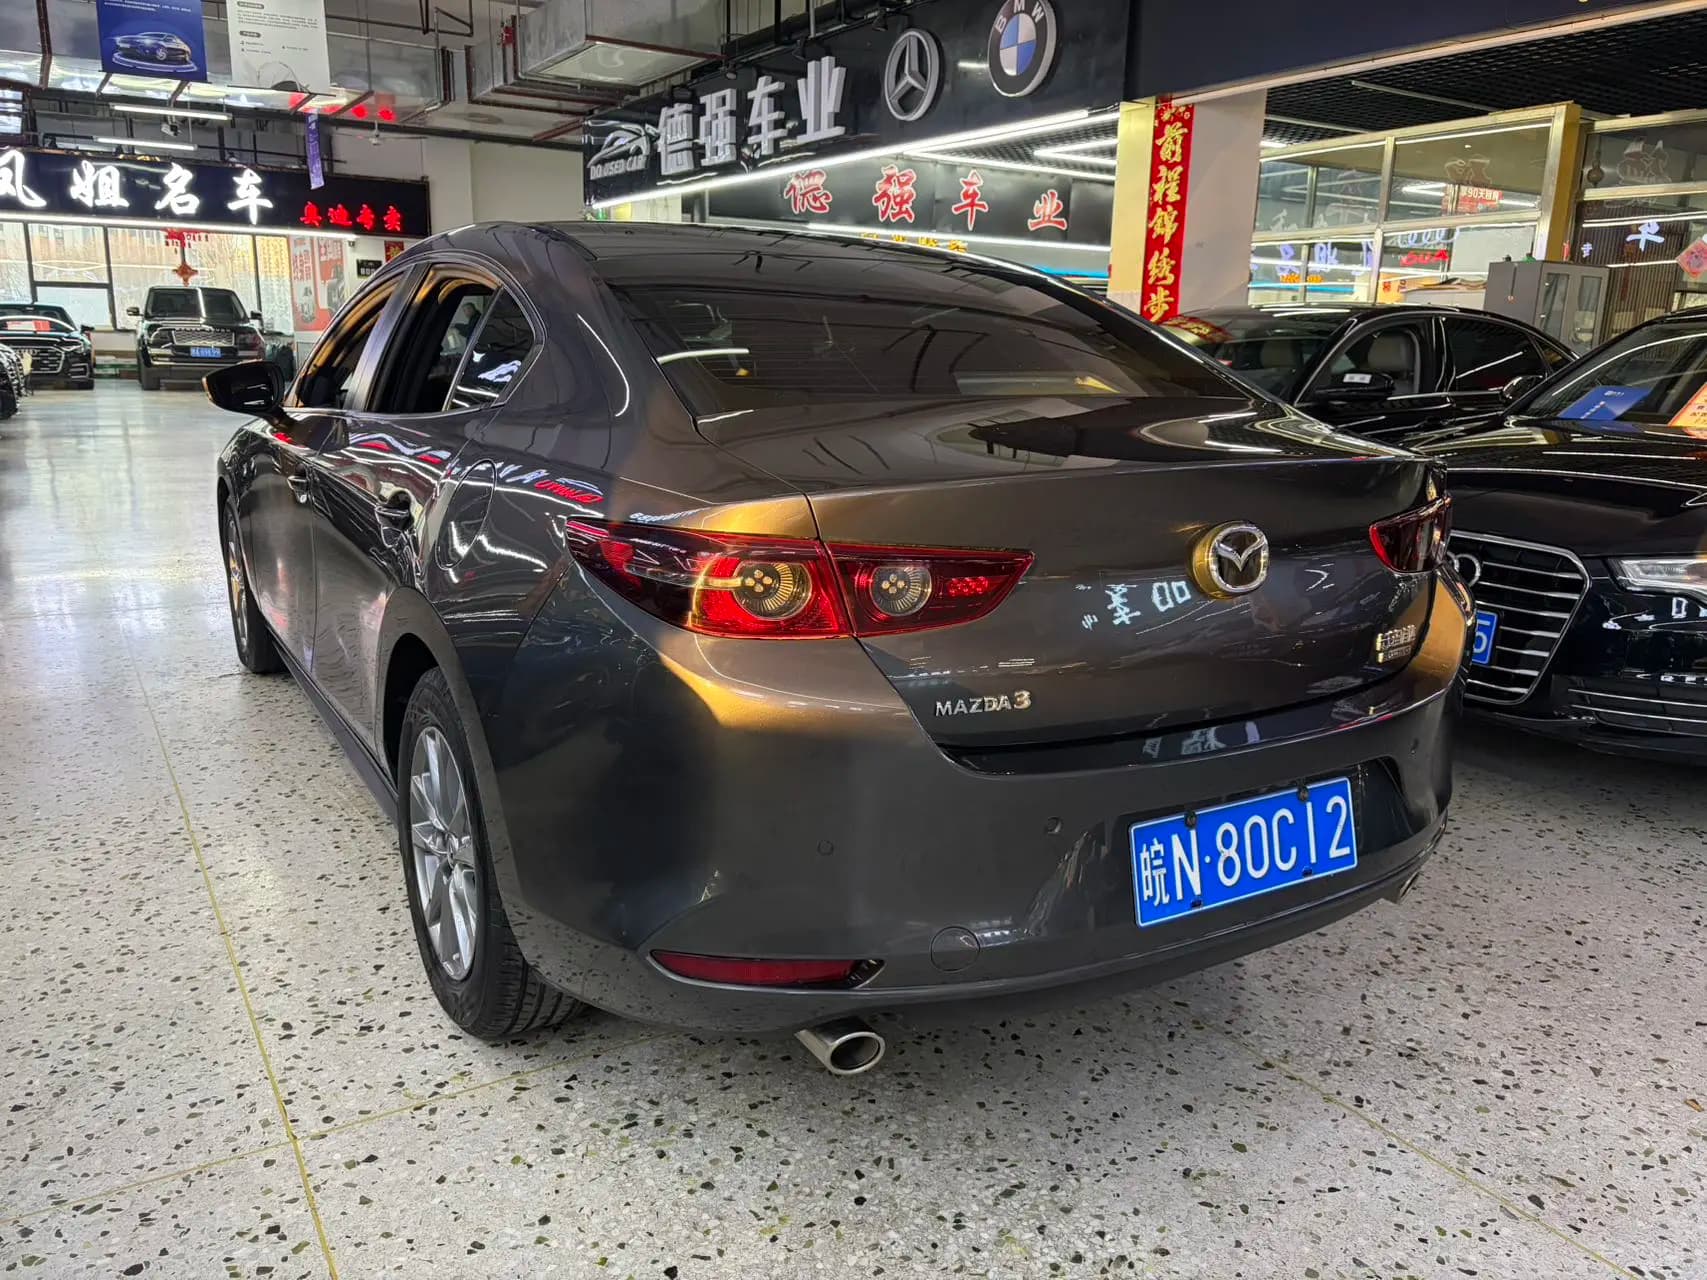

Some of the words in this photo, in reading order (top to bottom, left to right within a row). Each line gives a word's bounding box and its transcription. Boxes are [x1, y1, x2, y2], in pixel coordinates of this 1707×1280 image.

[995, 0, 1045, 33] BMW
[657, 56, 847, 176] 德强车业
[784, 164, 1068, 232] 德强车业
